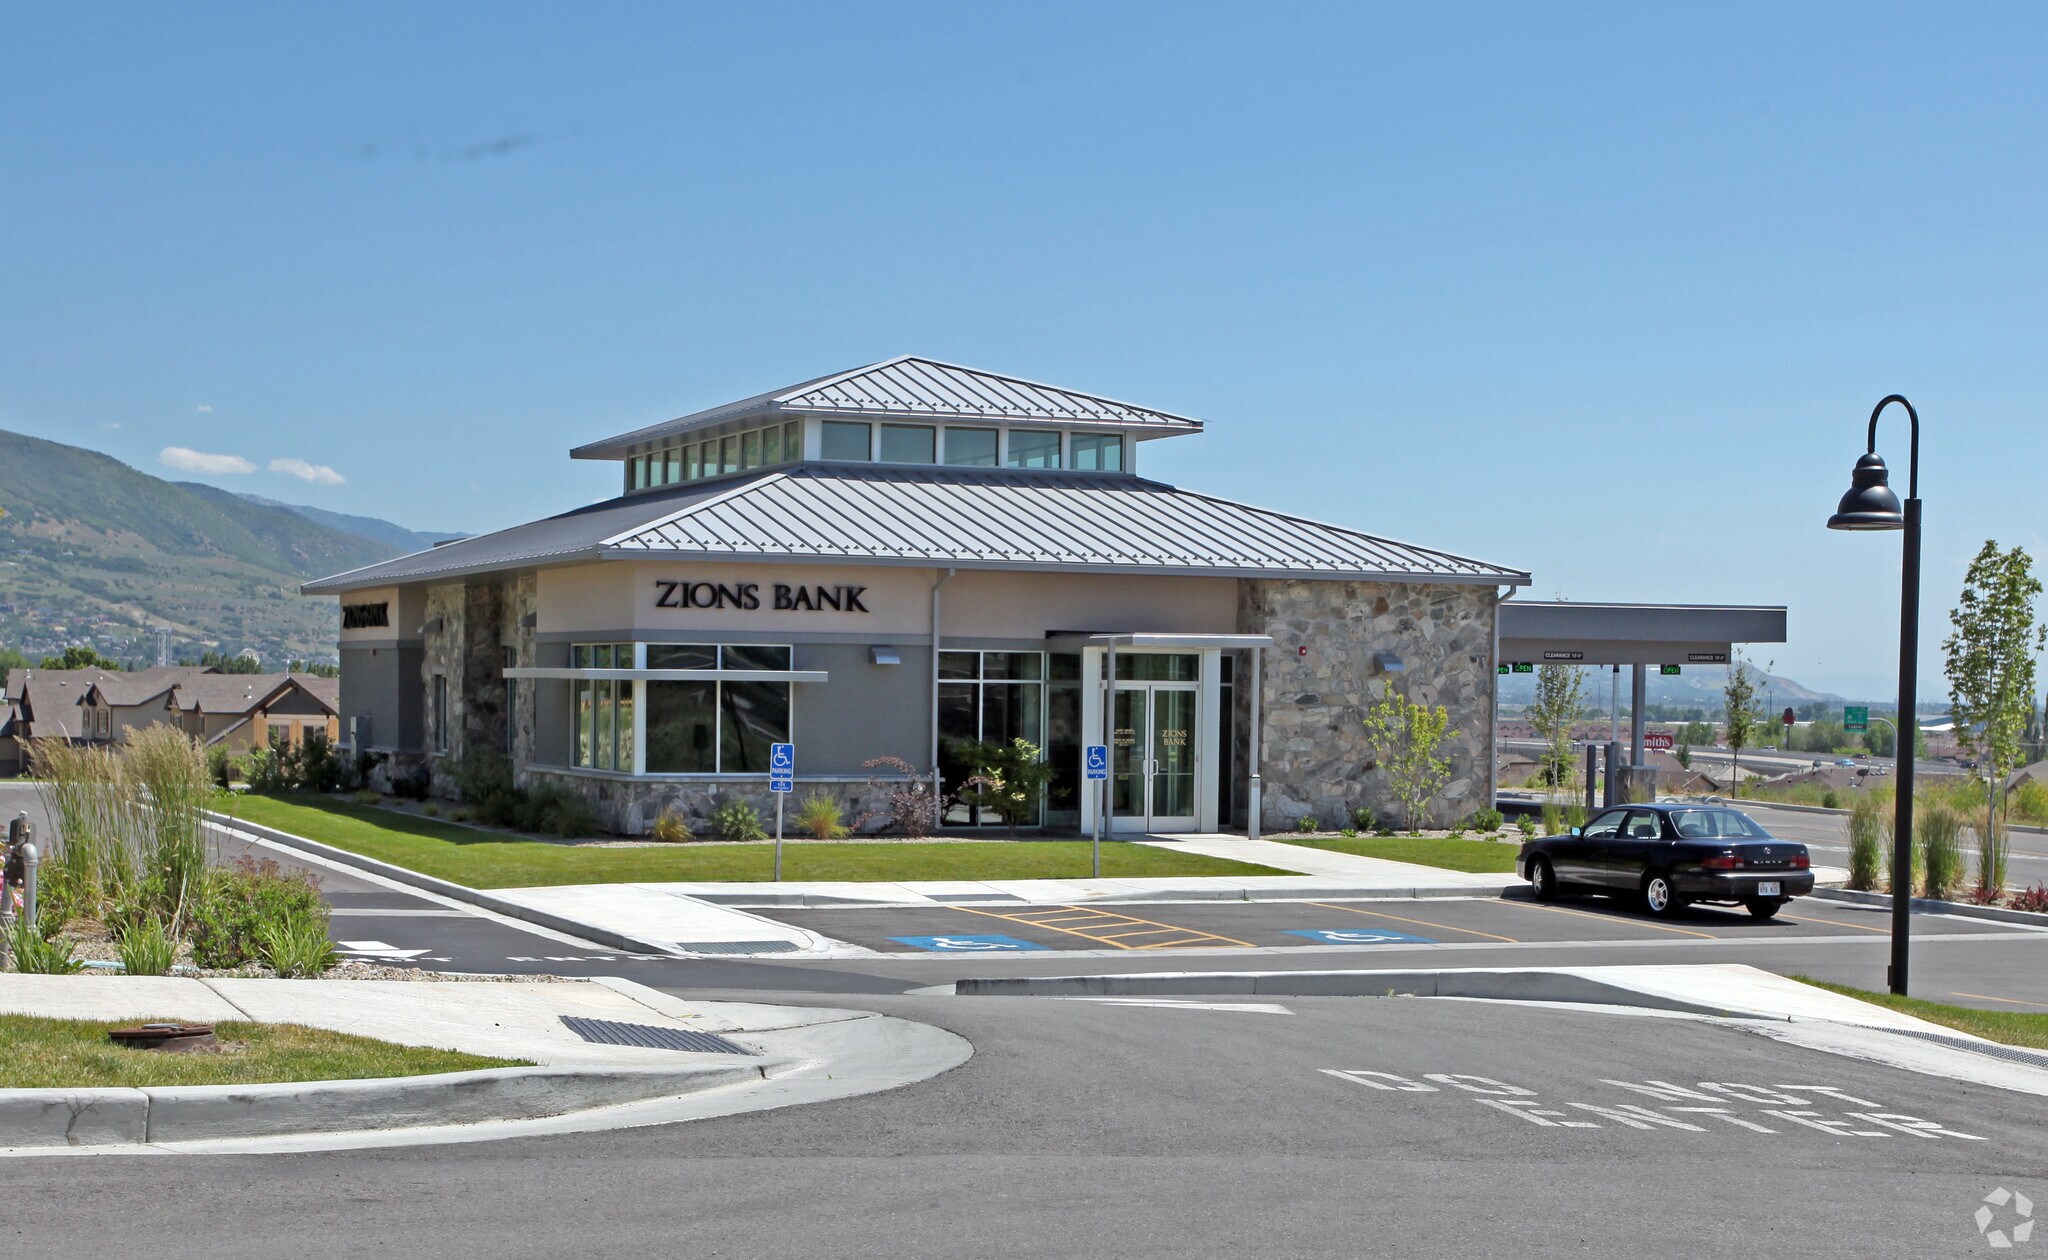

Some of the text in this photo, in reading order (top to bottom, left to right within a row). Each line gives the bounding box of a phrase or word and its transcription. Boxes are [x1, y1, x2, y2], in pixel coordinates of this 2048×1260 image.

[656, 580, 870, 613] ZIONS BANK
[1515, 664, 1532, 672] OPEN
[1162, 730, 1188, 738] ZIONS
[1163, 738, 1187, 746] BANK
[1643, 737, 1670, 747] mith's
[1316, 1069, 1888, 1107] DO NOT
[1472, 1098, 1990, 1140] ENTER
